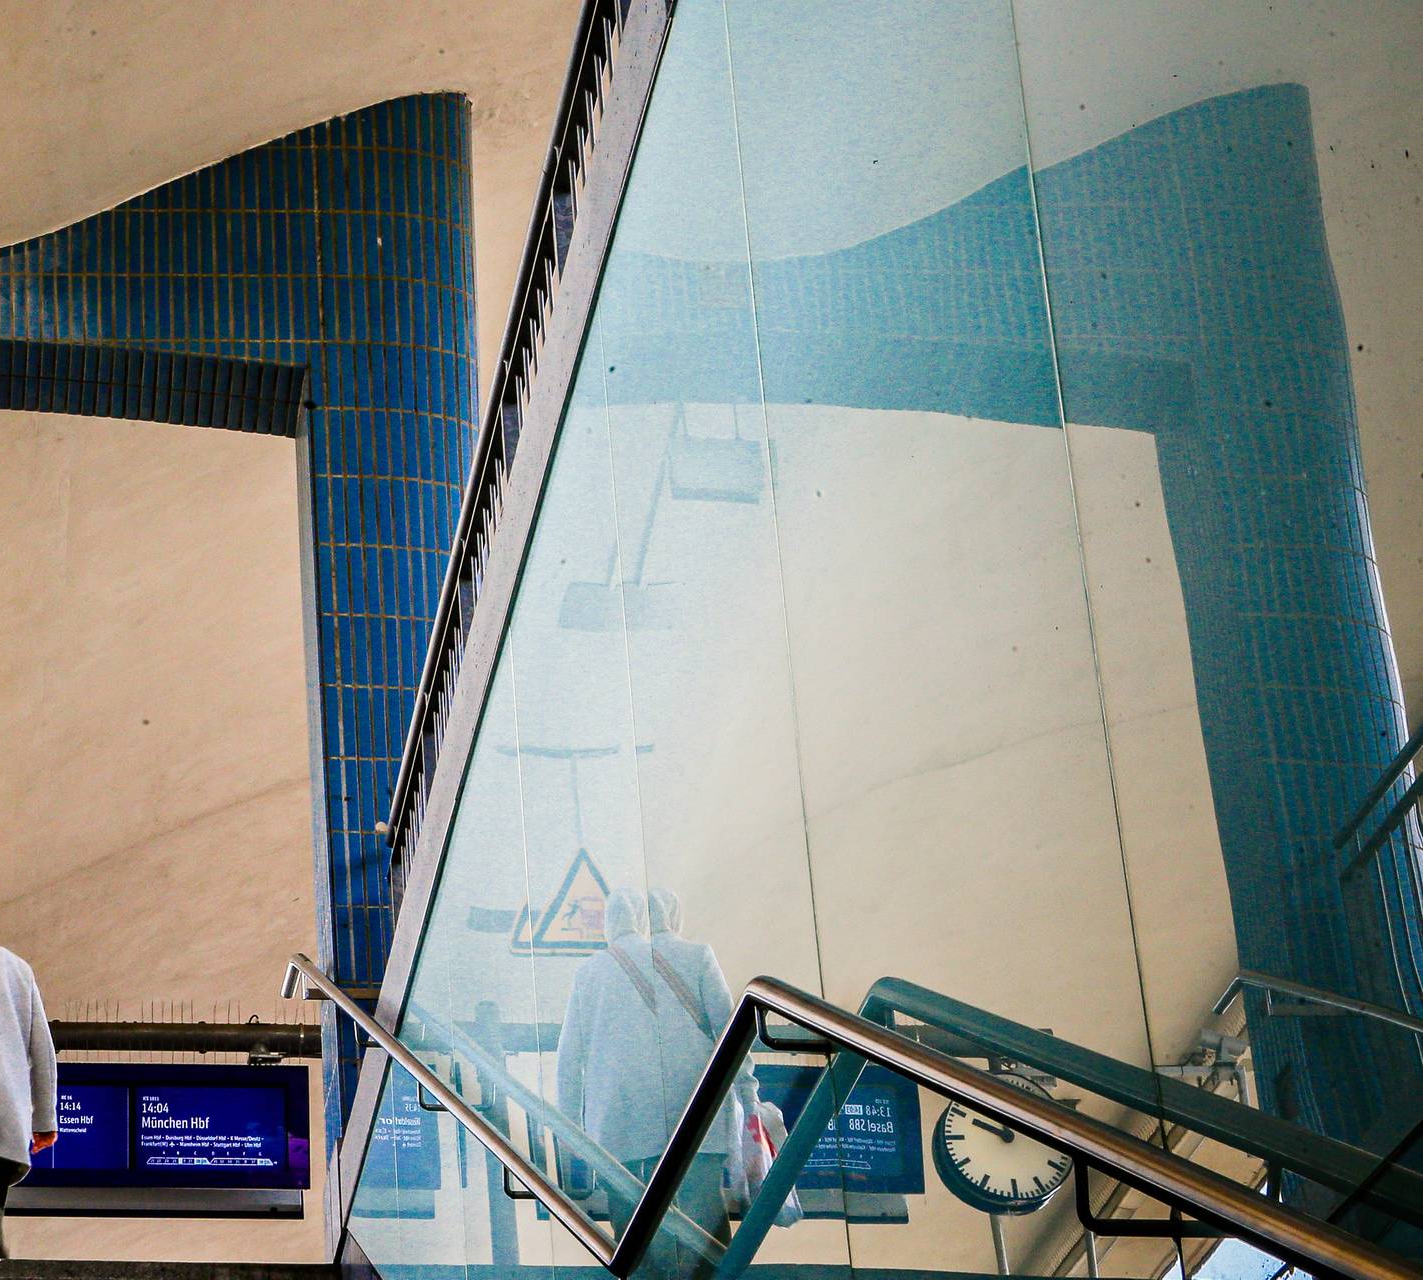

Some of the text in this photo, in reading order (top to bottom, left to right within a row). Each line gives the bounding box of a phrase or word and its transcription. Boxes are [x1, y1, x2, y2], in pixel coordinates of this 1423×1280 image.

[59, 1101, 81, 1111] 14:14
[142, 1102, 169, 1113] 14:04
[59, 1115, 94, 1124] Essen Hbf
[141, 1116, 210, 1129] München Hbf
